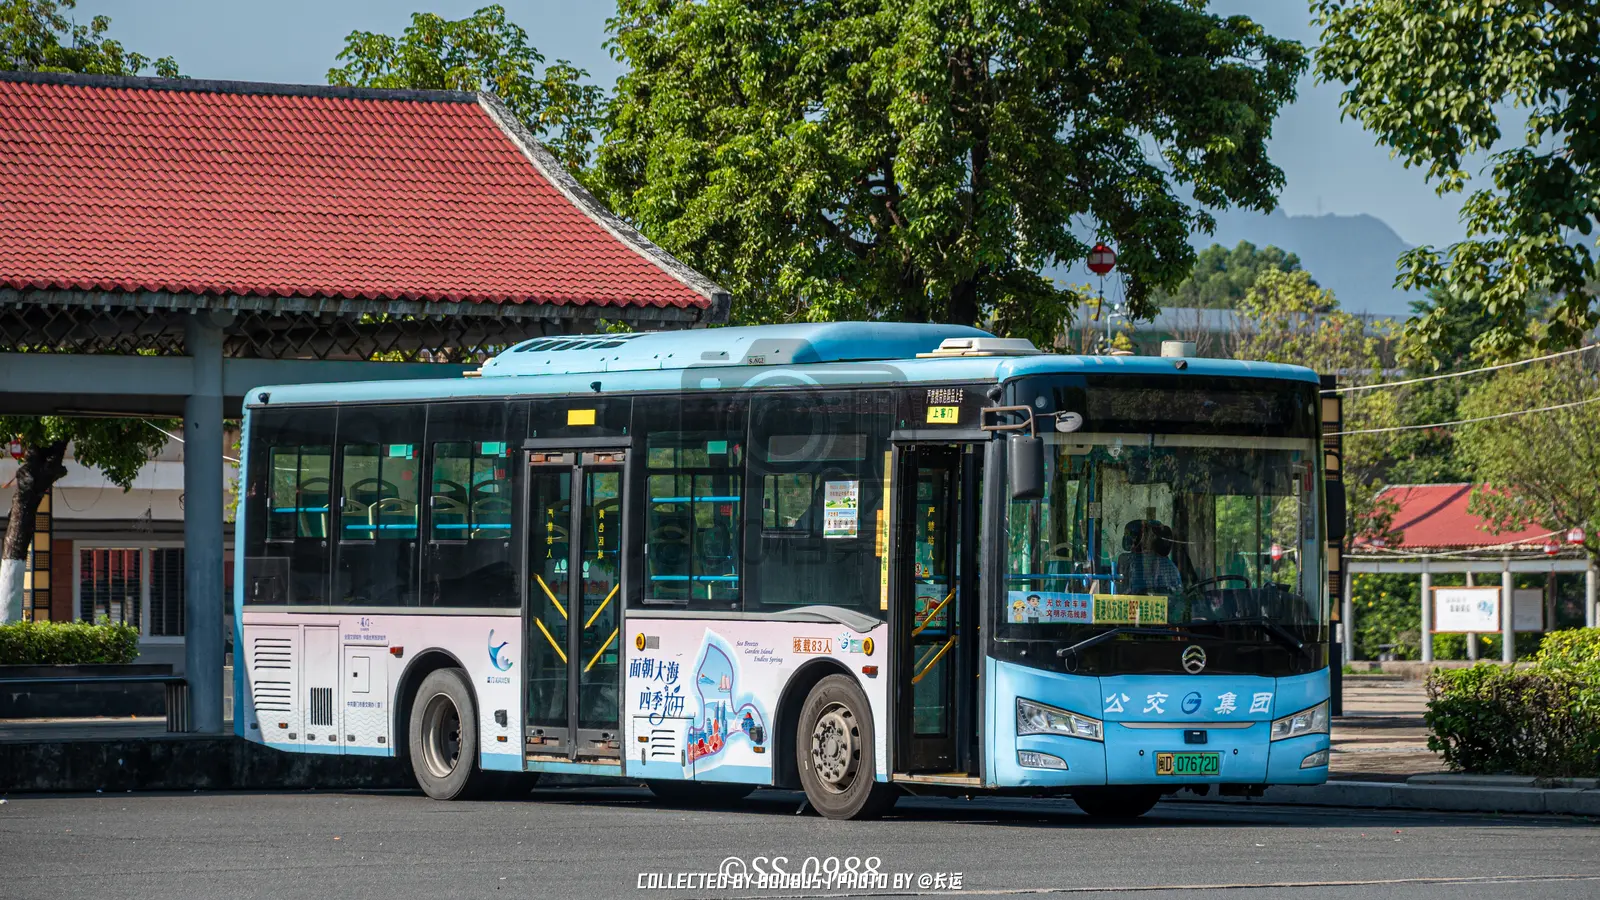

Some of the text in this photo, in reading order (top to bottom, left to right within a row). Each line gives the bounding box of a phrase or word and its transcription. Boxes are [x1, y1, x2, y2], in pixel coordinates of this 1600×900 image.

[933, 408, 953, 418] 上客门
[794, 638, 831, 653] 核载83人
[629, 658, 679, 684] 面朝大海
[639, 685, 685, 725] 四季花开
